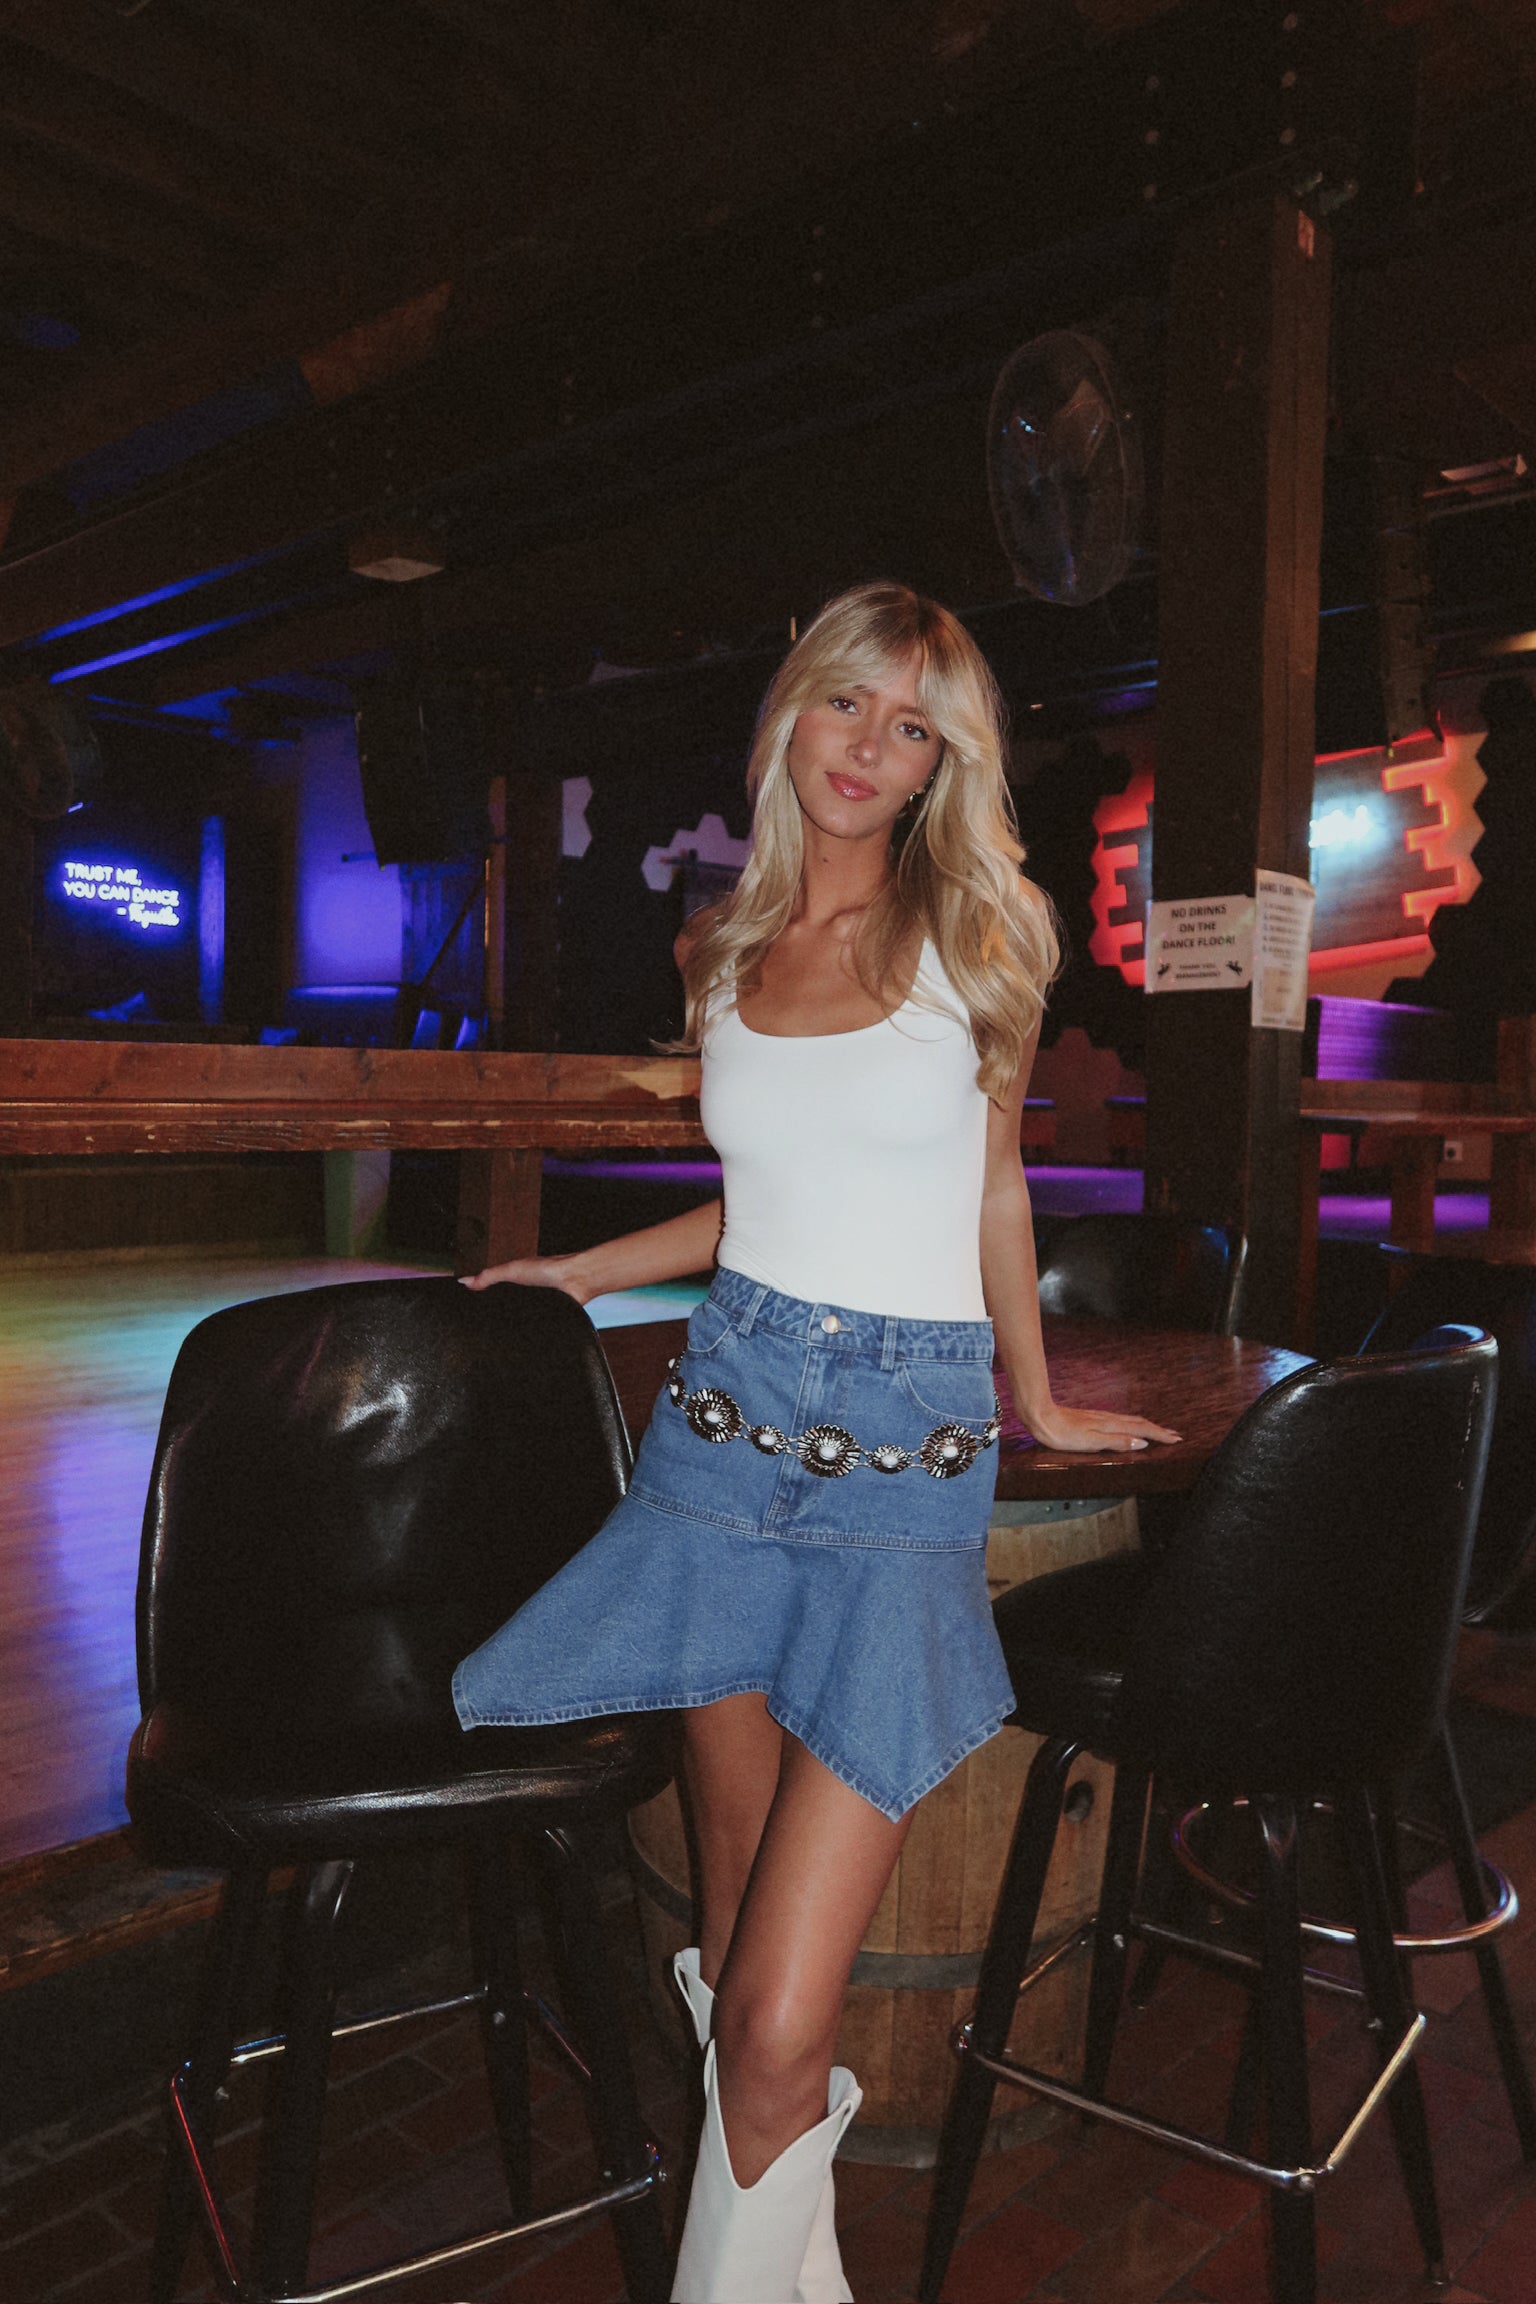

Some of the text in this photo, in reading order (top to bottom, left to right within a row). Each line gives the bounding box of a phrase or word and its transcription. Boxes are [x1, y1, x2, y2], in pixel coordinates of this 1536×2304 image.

[65, 863, 142, 886] TRUST ME,
[63, 881, 179, 906] YOU CAN DANCE
[1171, 904, 1226, 918] NO DRINKS
[1179, 921, 1216, 932] ON THE
[1162, 935, 1235, 949] DANCE FLOOR!
